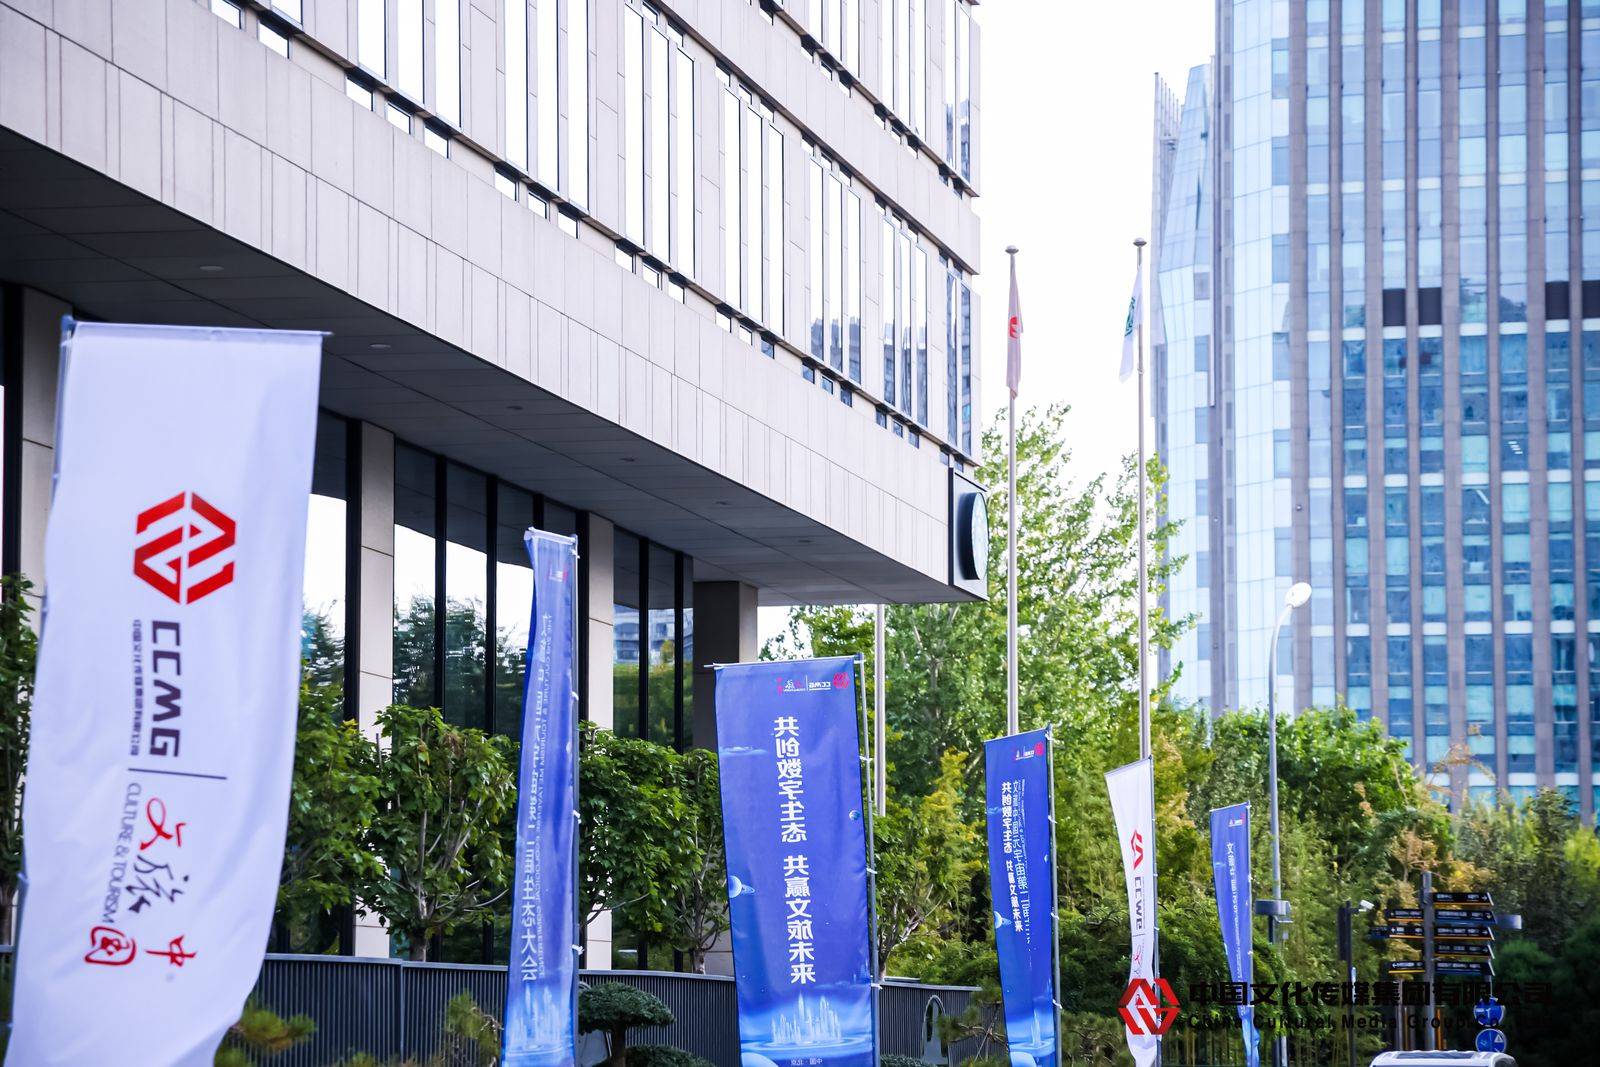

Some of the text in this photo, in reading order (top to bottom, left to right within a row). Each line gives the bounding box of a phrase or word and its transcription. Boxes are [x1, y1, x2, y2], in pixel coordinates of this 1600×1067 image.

[149, 620, 182, 758] CCMG
[101, 782, 141, 924] CULTURE & TOURISM
